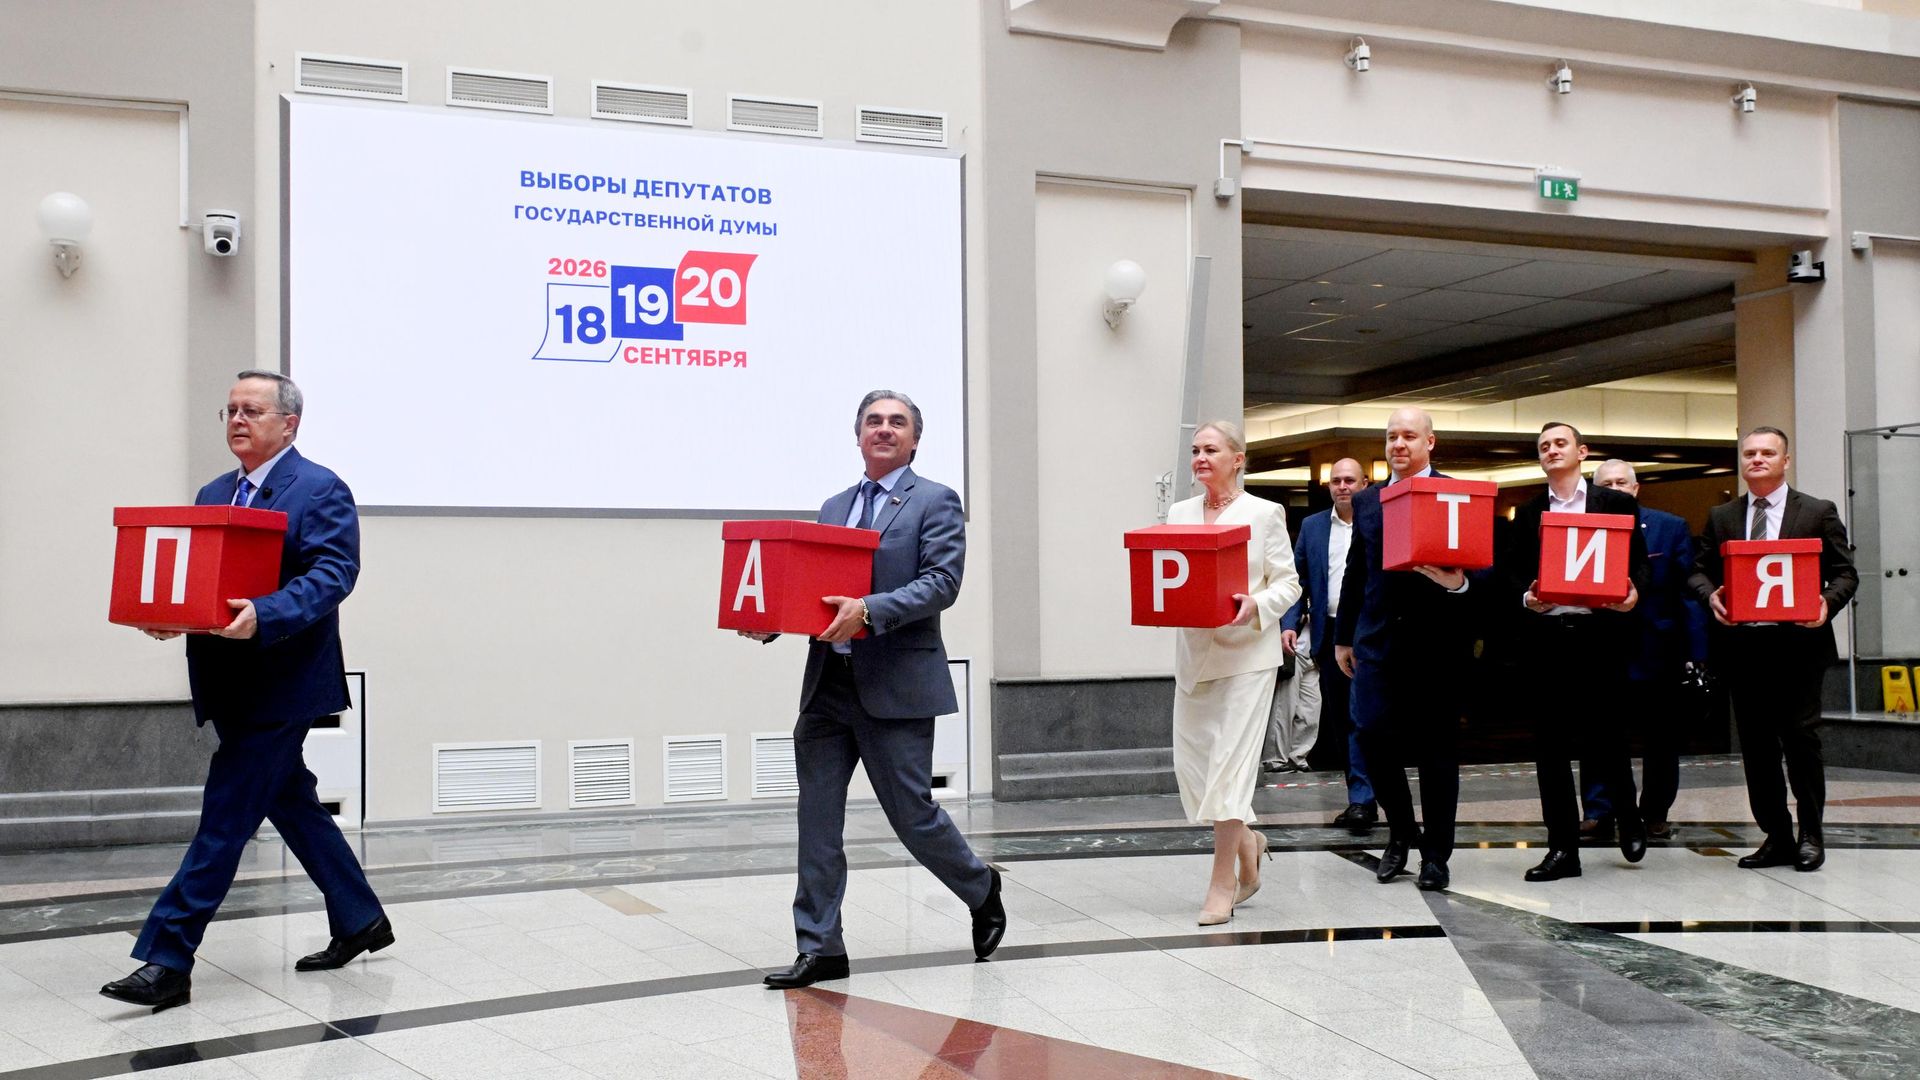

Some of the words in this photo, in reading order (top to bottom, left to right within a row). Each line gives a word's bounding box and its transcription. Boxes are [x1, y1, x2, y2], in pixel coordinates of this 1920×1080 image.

[520, 170, 627, 194] ВЫБОРЫ
[633, 178, 772, 205] ДЕПУТАТОВ
[514, 204, 714, 232] ГОСУДАРСТВЕННОЙ
[719, 218, 778, 236] ДУМЫ
[548, 257, 607, 279] 2026
[555, 304, 607, 345] 18
[617, 283, 669, 326] 19
[681, 266, 742, 309] 20
[623, 345, 747, 368] СЕНТЯБРЯ
[1436, 493, 1471, 550] Т
[140, 527, 191, 605] П
[733, 539, 766, 613] А
[1152, 549, 1190, 613] Р
[1564, 527, 1608, 584] И
[1755, 553, 1795, 609] Я
